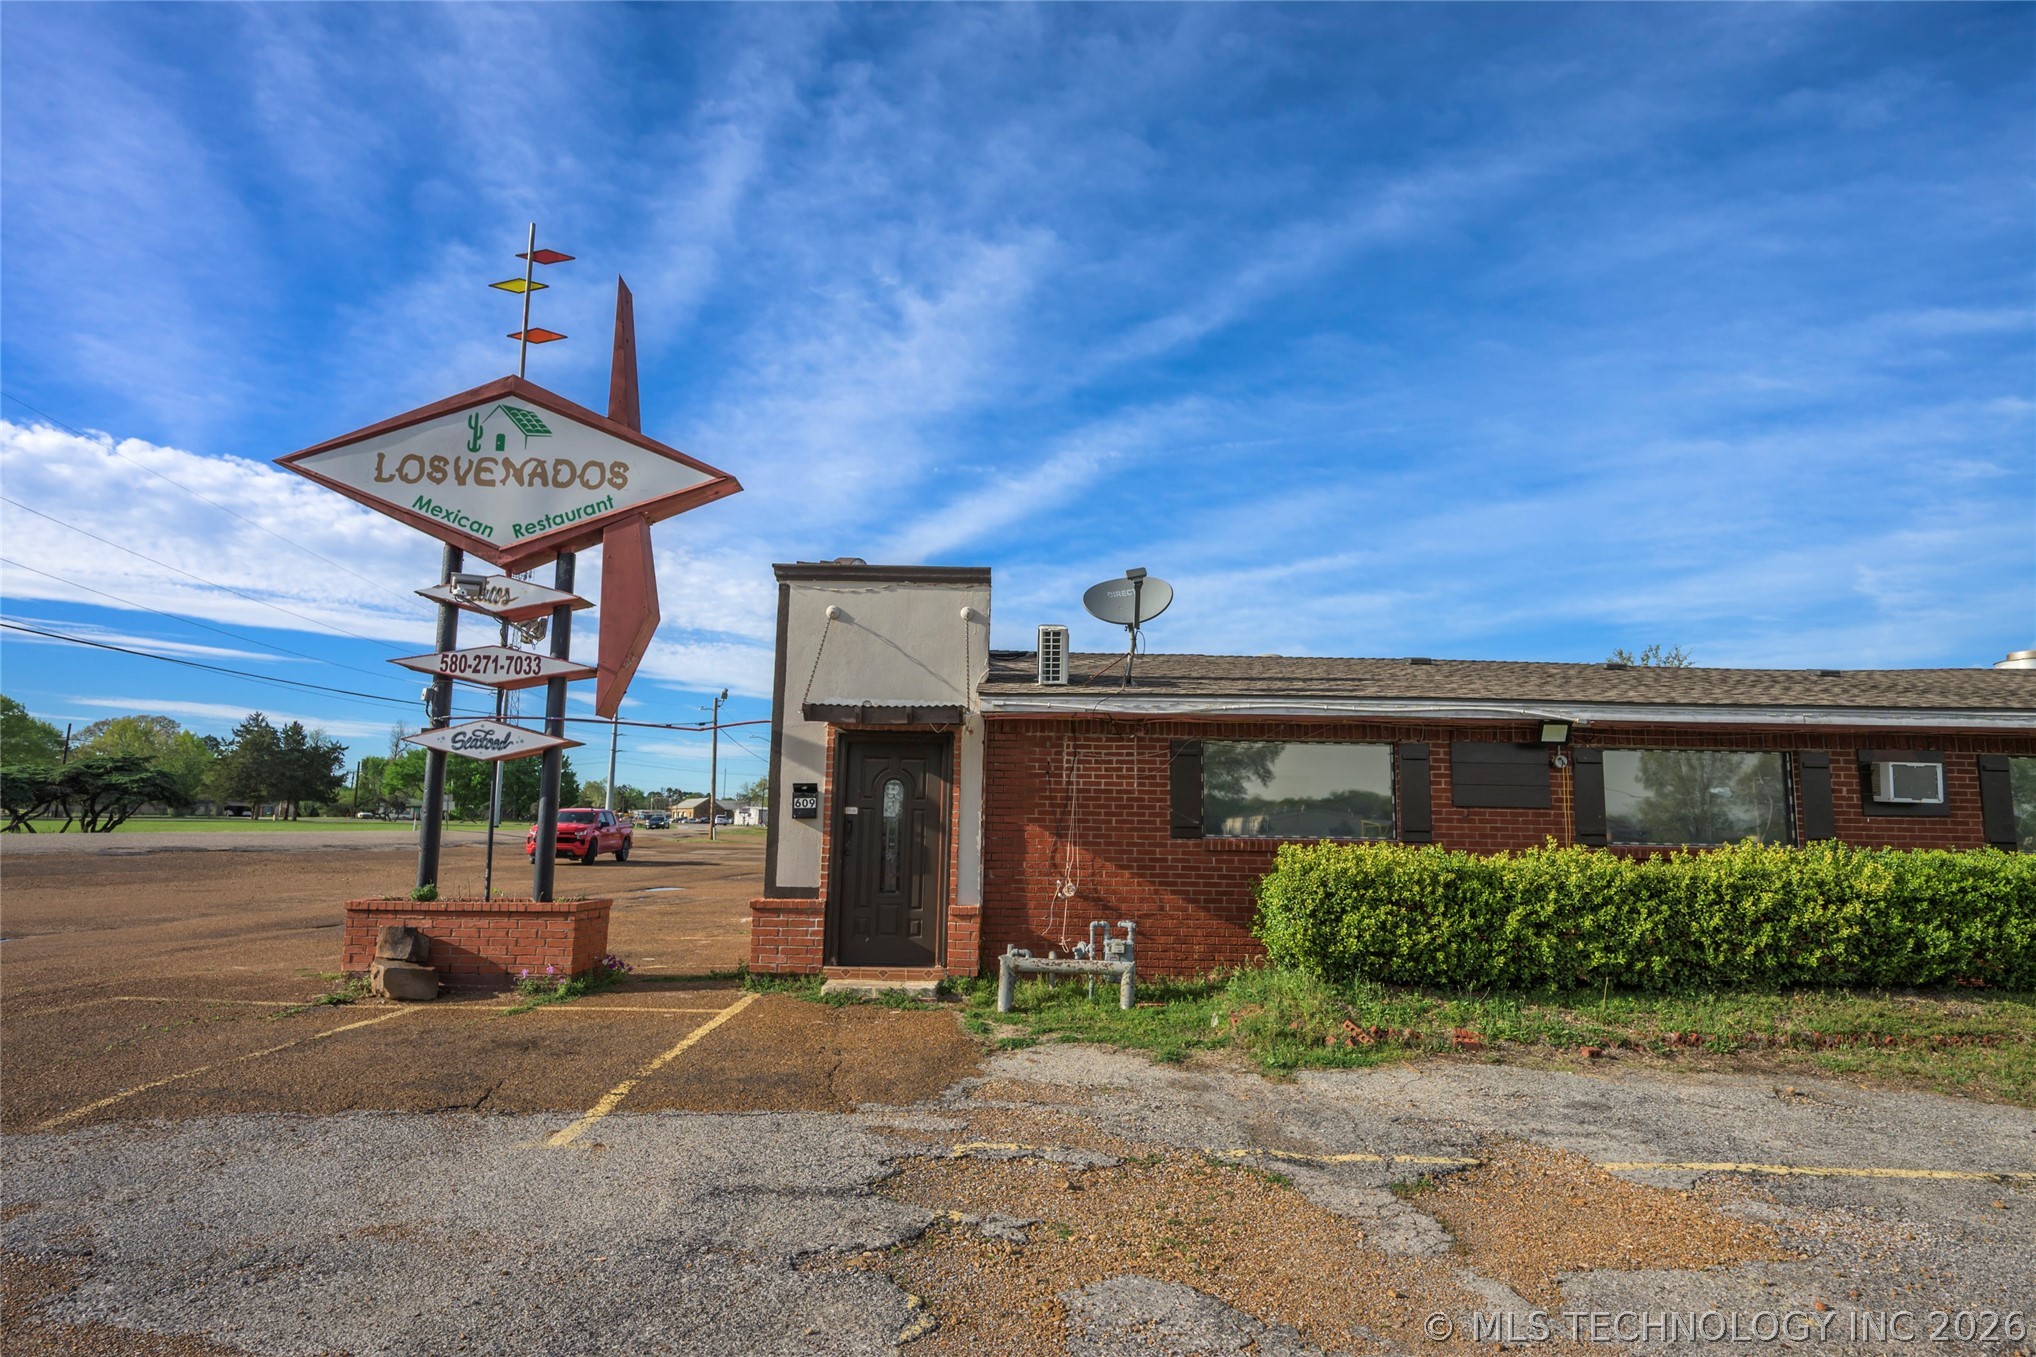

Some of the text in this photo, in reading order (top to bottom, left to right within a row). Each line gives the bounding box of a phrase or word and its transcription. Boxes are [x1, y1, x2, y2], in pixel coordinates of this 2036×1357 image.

[411, 494, 615, 538] Mexican Restaurant
[439, 654, 542, 675] 580-271-7033
[451, 728, 515, 751] Seafood
[795, 798, 815, 808] 609
